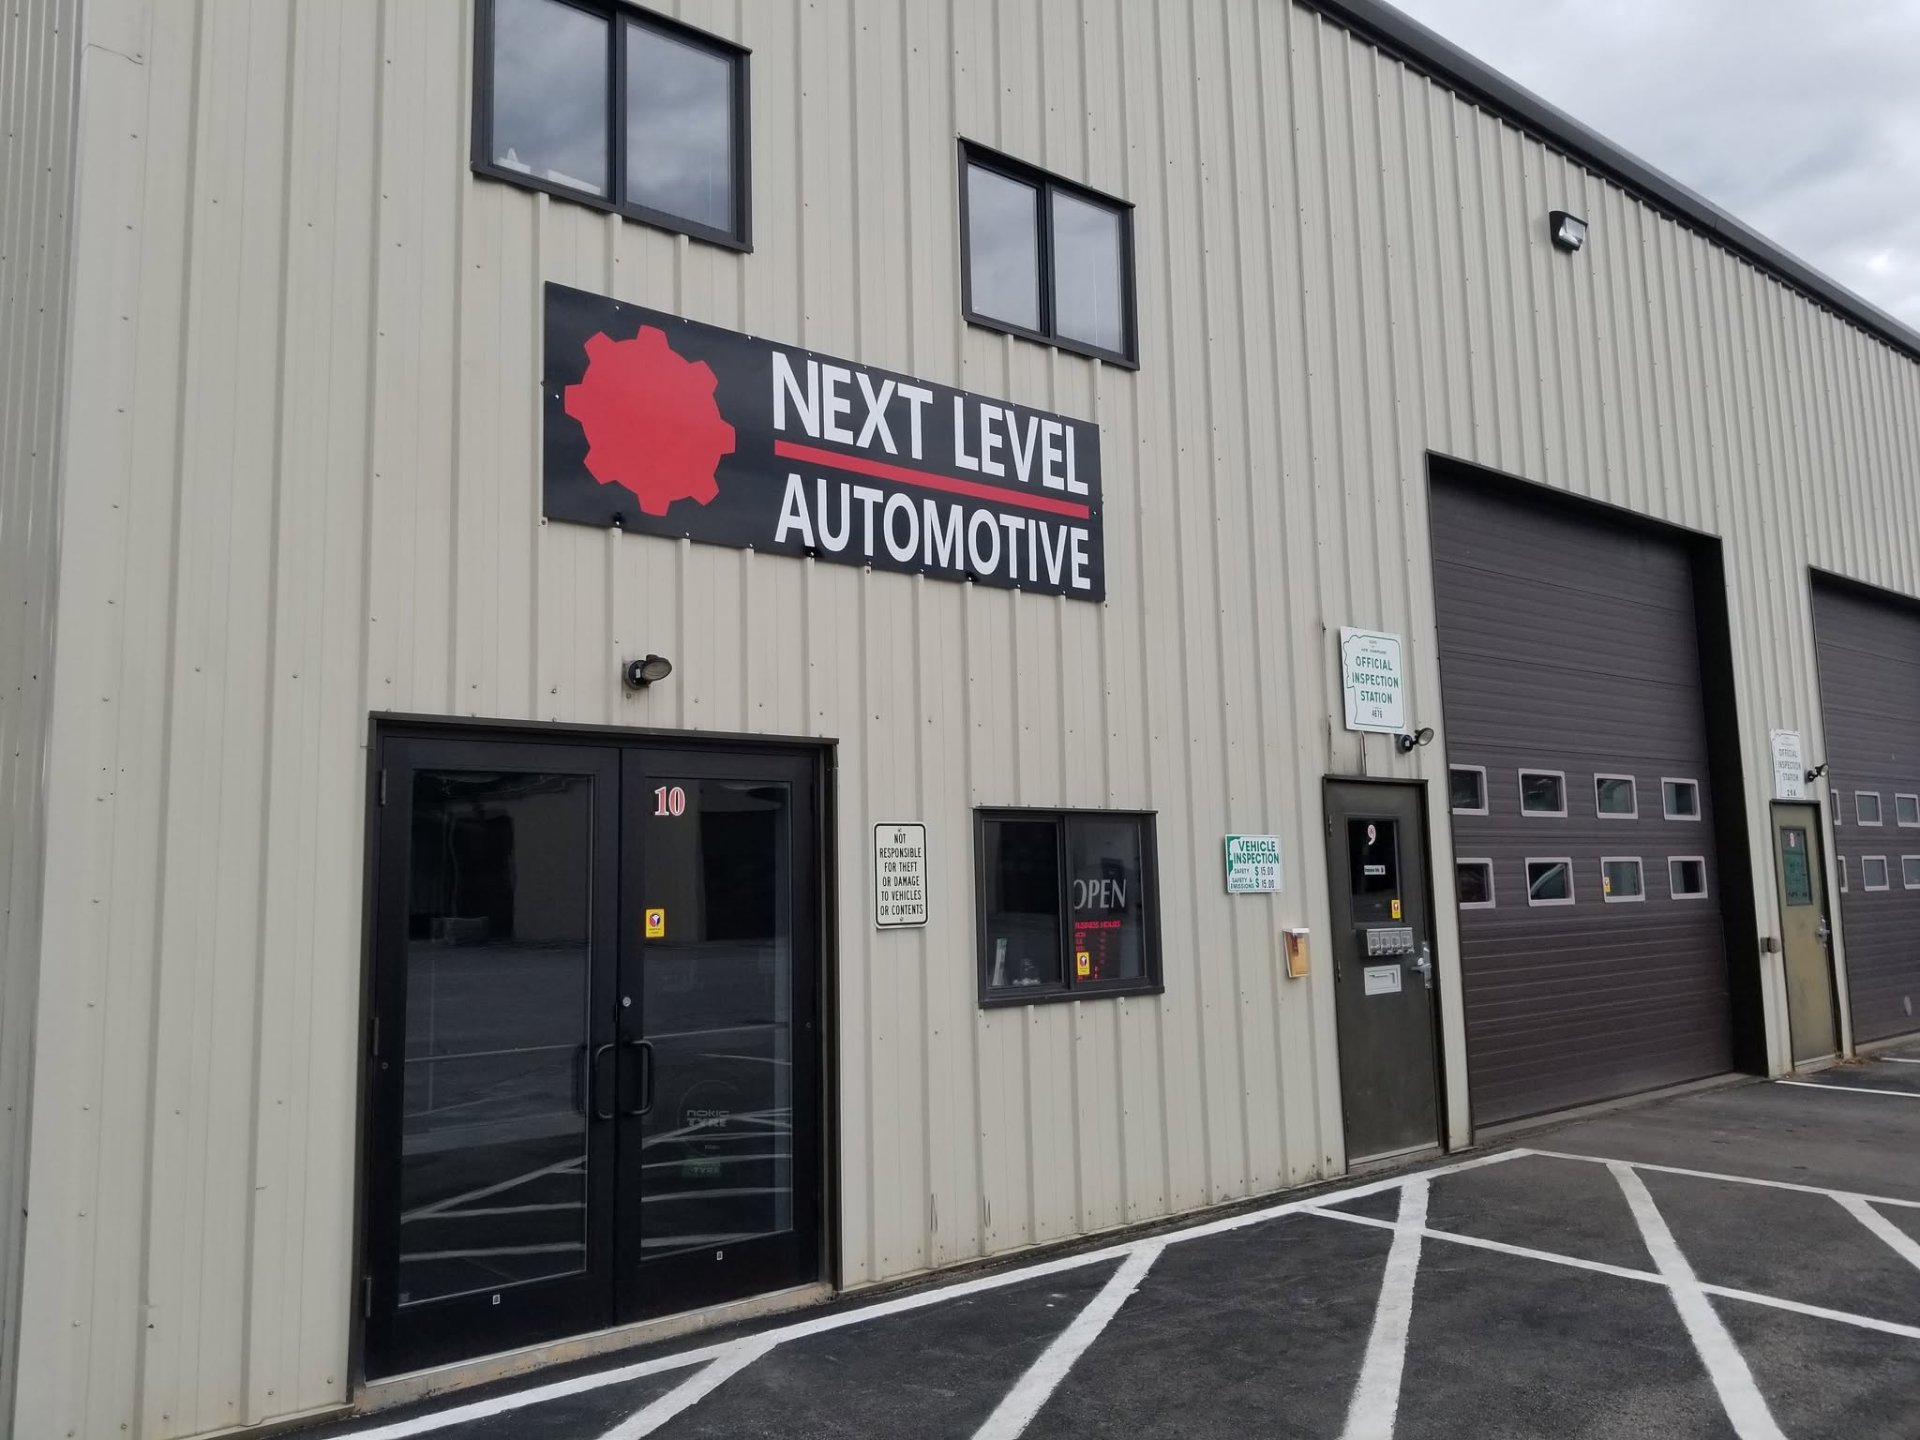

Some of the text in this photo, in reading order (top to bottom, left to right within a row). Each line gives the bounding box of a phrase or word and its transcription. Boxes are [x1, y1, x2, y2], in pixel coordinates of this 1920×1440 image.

[772, 350, 1088, 496] NEXT LEVEL
[774, 473, 1091, 590] AUTOMOTIVE
[1355, 656, 1392, 671] OFFICIAL
[1352, 671, 1399, 688] INSPECTION
[1360, 690, 1393, 704] STATION
[654, 786, 686, 816] 10
[893, 833, 906, 844] NOT
[1367, 824, 1377, 845] 9
[879, 847, 922, 858] RESPONSIBLE
[1238, 841, 1276, 852] VEHICLE
[1233, 852, 1279, 864] INSPECTION
[884, 861, 917, 872] FOR THEFT
[882, 875, 920, 887] OR DAMAGE
[881, 890, 922, 901] TO VEHICLES
[880, 904, 924, 915] OR CONTENTS
